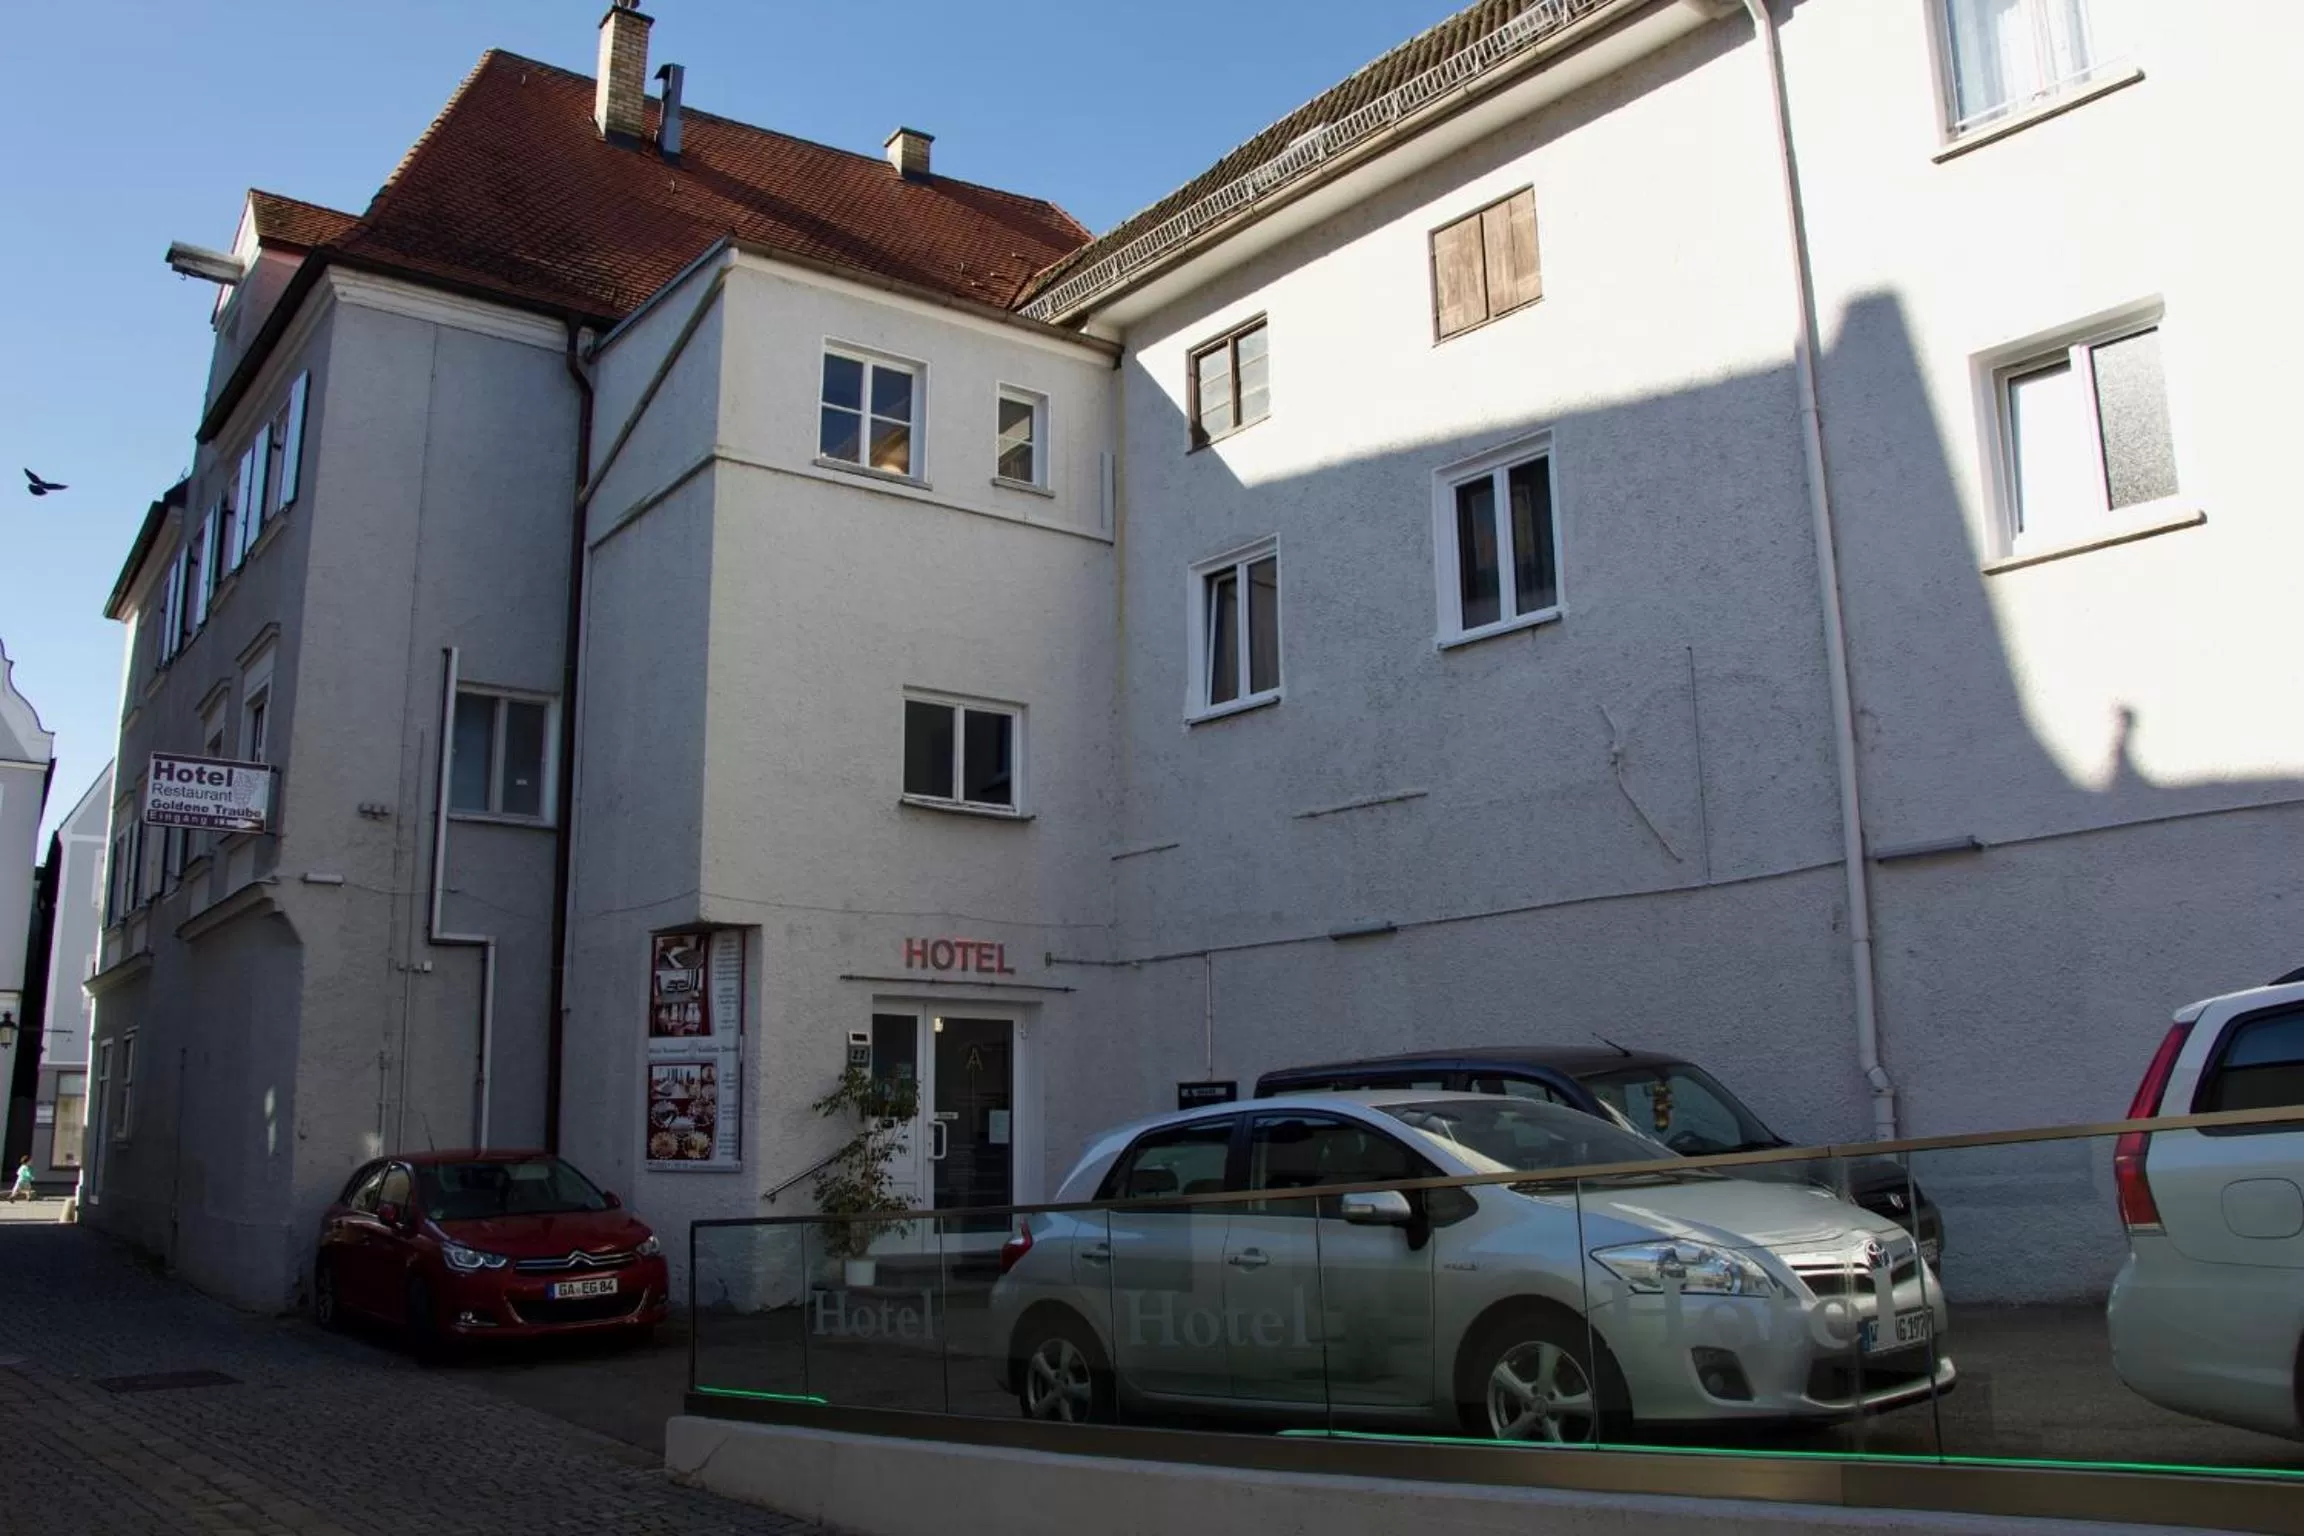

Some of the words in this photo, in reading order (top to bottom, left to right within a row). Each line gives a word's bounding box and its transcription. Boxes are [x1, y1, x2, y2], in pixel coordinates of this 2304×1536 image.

[153, 761, 234, 788] Hotel
[151, 783, 233, 802] Restaurant
[147, 809, 209, 826] Eingang
[151, 799, 210, 813] Goldene
[213, 804, 262, 818] Traube
[903, 937, 1016, 976] HOTEL
[581, 1281, 597, 1294] EG
[600, 1279, 613, 1293] 84
[812, 1288, 935, 1340] Hotel
[1124, 1284, 1312, 1348] Hotel
[1602, 1264, 1897, 1352] Hotel
